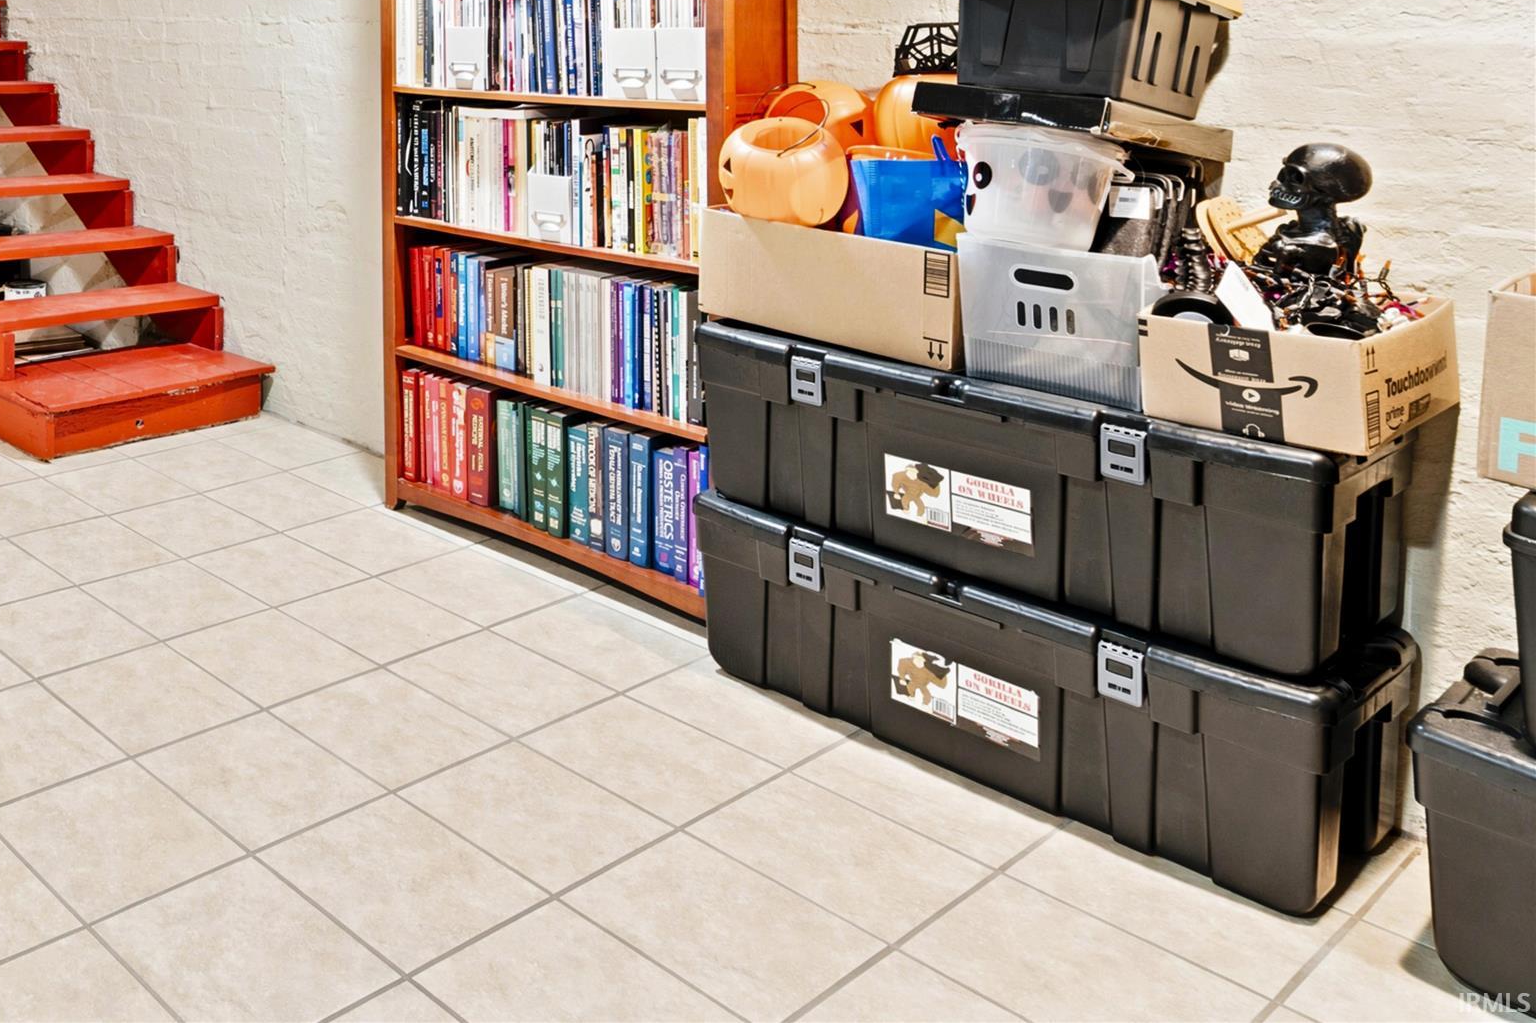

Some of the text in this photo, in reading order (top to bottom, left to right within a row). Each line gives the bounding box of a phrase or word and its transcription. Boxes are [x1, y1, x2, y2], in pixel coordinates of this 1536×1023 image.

[500, 283, 509, 335] Writer's Market
[1385, 406, 1405, 423] prime
[588, 466, 596, 477] OF
[588, 478, 597, 514] MEDICINE
[958, 485, 1024, 510] ON WHEELS
[966, 477, 1015, 497] GORILLA
[663, 460, 674, 541] OBSTETRICS
[965, 679, 1032, 713] ON WHEELS
[974, 673, 1022, 698] GORILLA
